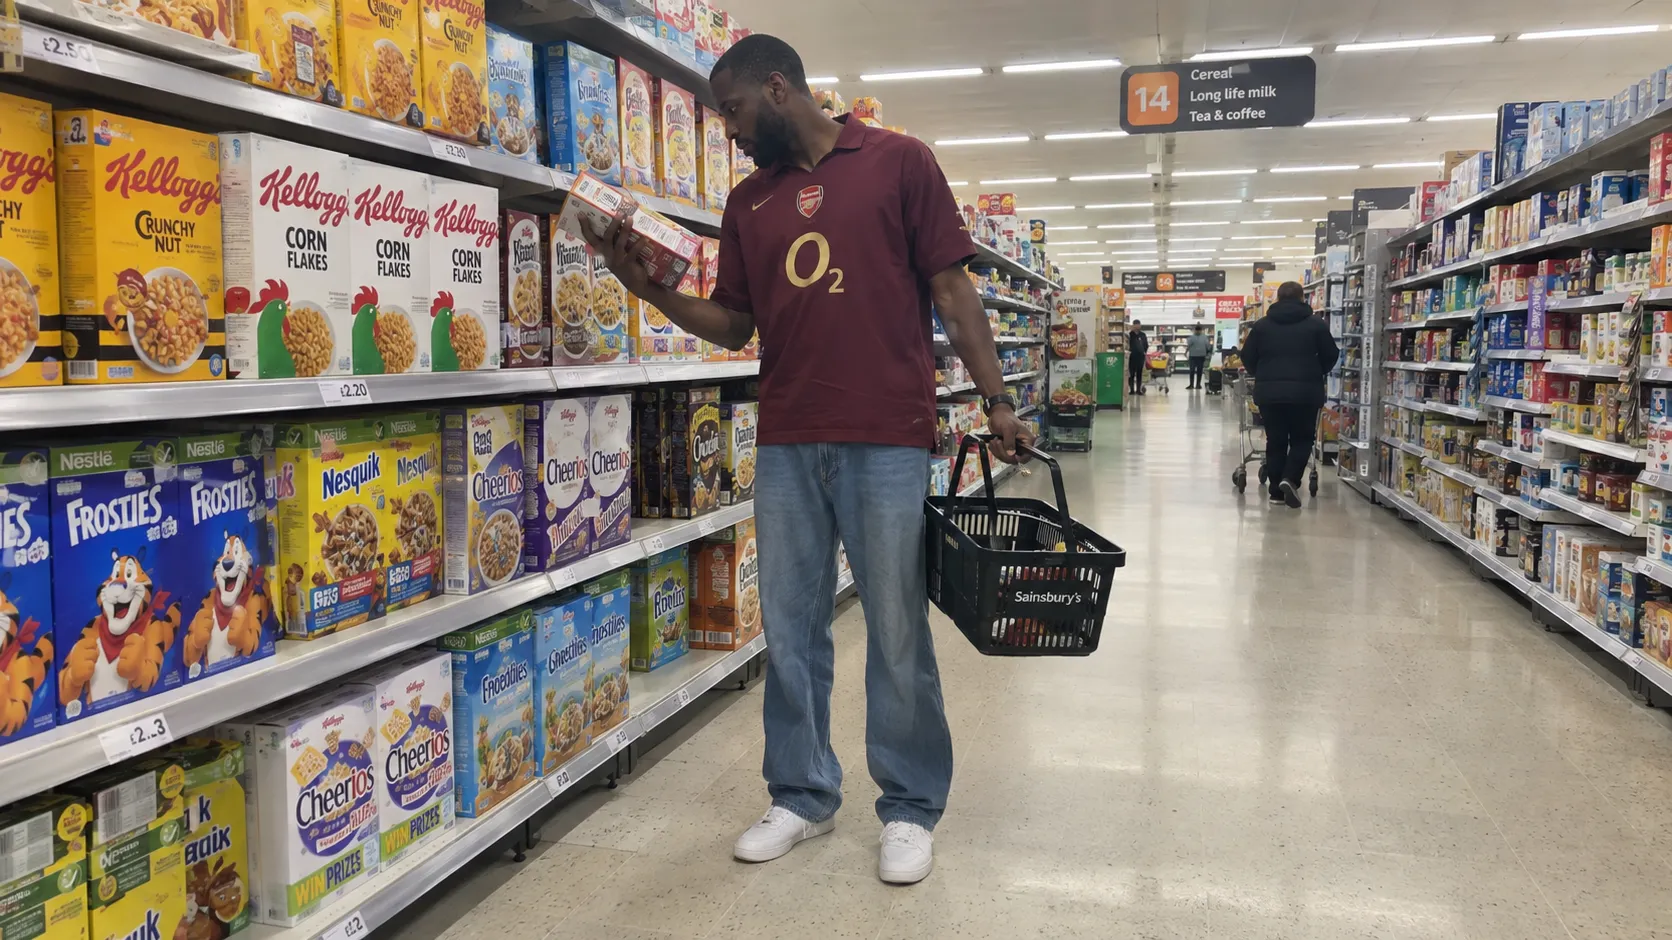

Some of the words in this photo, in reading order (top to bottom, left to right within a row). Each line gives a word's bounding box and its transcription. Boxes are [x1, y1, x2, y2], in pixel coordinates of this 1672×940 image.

[1190, 67, 1233, 80] Cereal
[1135, 85, 1170, 113] 14
[1190, 90, 1221, 103] Long
[1224, 87, 1245, 100] life
[1248, 85, 1276, 98] milk
[1189, 111, 1211, 122] Tea
[1214, 110, 1224, 121] &
[1226, 108, 1266, 120] coffee
[135, 210, 195, 239] CRUNCHY
[155, 237, 181, 253] NUT
[286, 227, 327, 252] CORN
[376, 239, 410, 261] CORN
[287, 250, 328, 271] FLAKES
[377, 260, 411, 278] FLAKES
[452, 248, 482, 268] CORN
[452, 267, 482, 284] FLAKES
[340, 383, 367, 397] £2.20
[397, 442, 438, 486] Nesquik
[547, 456, 588, 485] Cheerios
[592, 447, 630, 475] Cheerios
[322, 452, 381, 499] Nesquik
[473, 467, 523, 502] Cheerios
[190, 472, 256, 525] FROSTIES
[66, 484, 162, 546] FROSTIES
[1014, 591, 1082, 606] Sainsbury's
[386, 729, 450, 782] Cheerios
[296, 765, 375, 826] Cheerios
[385, 823, 409, 855] WIN
[409, 805, 440, 840] PRIZES
[296, 873, 325, 907] WIN
[326, 850, 361, 889] PRIZES
